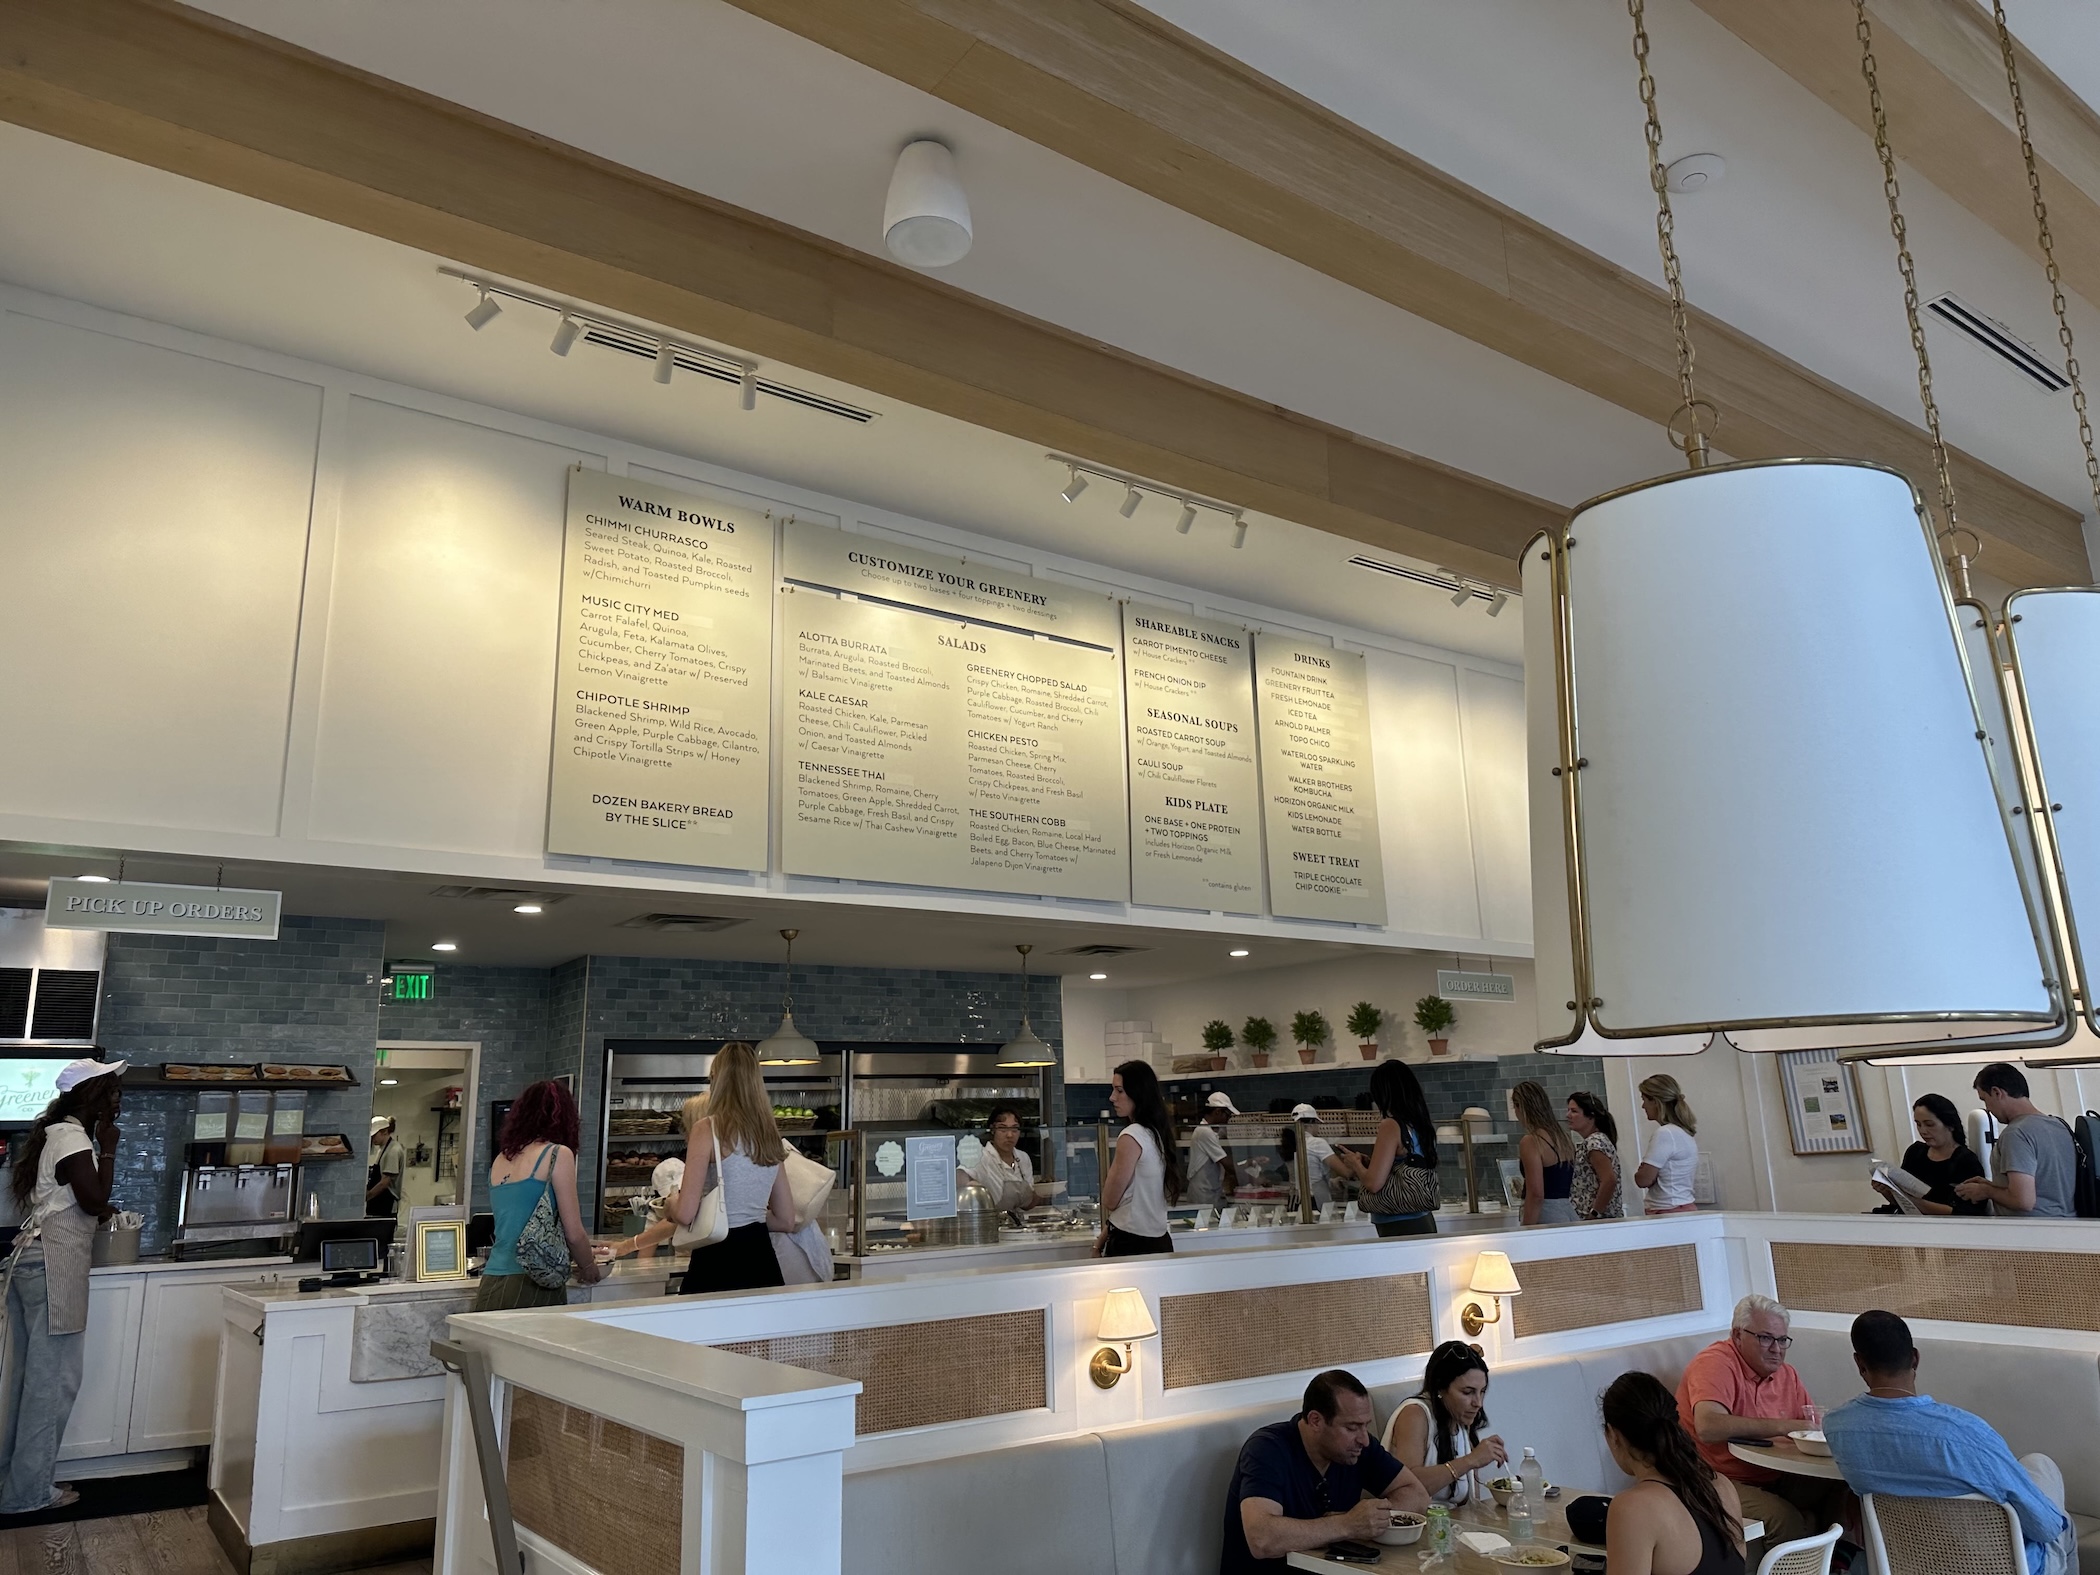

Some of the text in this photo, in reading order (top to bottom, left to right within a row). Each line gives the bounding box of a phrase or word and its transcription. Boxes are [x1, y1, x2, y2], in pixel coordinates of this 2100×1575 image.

[618, 495, 735, 534] WARM BOWLS
[585, 514, 708, 550] CHIMMI CHURRASCO
[584, 527, 753, 574] Seared Steak, Quinoa, Kale, Roasted
[584, 540, 615, 556] Sweet
[617, 548, 652, 565] Potato,
[654, 556, 693, 573] Roasted
[582, 569, 651, 590] w/Chimichurri
[583, 553, 750, 598] Radish, and Toasted Pumpkin seeds
[848, 551, 1047, 607] CUSTOMIZE YOUR GREENERY
[581, 594, 680, 622] MUSIC CITY MED
[580, 607, 689, 638] Carrot Falafel, Quinoa,
[1135, 617, 1240, 649] SHAREABLE SNACKS
[579, 621, 728, 658] Arugula, Feta, Kalamata Olives,
[798, 630, 888, 655] ALOTTA BURRATA
[937, 635, 987, 654] SALADS
[578, 635, 747, 676] Cucumber, Cherry Tomatoes, Crispy
[1132, 636, 1228, 665] CARROT PIMENTO CHEESE
[1294, 652, 1331, 669] DRINKS
[577, 662, 669, 687] Lemon Vinaigrette
[578, 648, 631, 668] Chickpeas,
[633, 660, 652, 670] and
[688, 668, 701, 680] w/
[703, 670, 749, 687] Preserved
[966, 663, 1088, 693] GREENERY CHOPPED SALAD
[1271, 666, 1328, 686] FOUNTAIN DRINK
[1134, 668, 1207, 689] FRENCH ONION DIP
[1264, 678, 1335, 699] GREENERY FRUIT TEA
[576, 689, 690, 716] CHIPOTLE SHRIMP
[799, 688, 869, 708] KALE CAESAR
[1270, 692, 1332, 711] FRESH LEMONADE
[575, 703, 758, 741] Blackened Shrimp, Wild Rice, Avocado,
[798, 701, 833, 715] Roasted
[890, 716, 929, 730] Parmesan
[1147, 707, 1238, 733] SEASONAL SOUPS
[1287, 708, 1318, 721] ICED TEA
[1136, 725, 1226, 748] ROASTED CARROT SOUP
[1274, 719, 1331, 736] ARNOLD PALMER
[967, 729, 1039, 748] CHICKEN PESTO
[1289, 734, 1331, 749] TOPO CHICO
[573, 746, 673, 768] Chipotle Vinaigrette
[1137, 757, 1184, 772] CAULI SOUP
[1280, 748, 1356, 768] WATERLOO SPARKLING
[1299, 761, 1323, 772] WATER
[798, 760, 885, 781] TENNESSEE THAI
[798, 773, 841, 788] Blackened
[913, 788, 939, 802] Cherry
[1287, 775, 1353, 793] WALKER BROTHERS
[1293, 785, 1333, 798] KOMBUCHA
[592, 794, 734, 819] DOZEN BAKERY BREAD
[1165, 796, 1228, 815] KIDS PLATE
[1273, 795, 1355, 815] HORIZON ORGANIC MILK
[605, 812, 621, 823] BY
[625, 814, 649, 826] THE
[968, 808, 1066, 828] THE SOUTHERN COBB
[1144, 814, 1162, 825] ONE
[1163, 817, 1184, 828] BASE
[1190, 821, 1207, 831] ONE
[1208, 823, 1241, 835] PROTEIN
[1287, 810, 1342, 826] KIDS LEMONADE
[1150, 827, 1169, 837] TWO
[1169, 829, 1209, 842] TOPPINGS
[1291, 824, 1342, 839] WATER BOTTLE
[1292, 851, 1360, 869] SWEET TREAT
[1233, 882, 1252, 892] gluten
[1293, 871, 1363, 887] TRIPLE CHOCOLATE
[1295, 882, 1313, 891] CHIP
[65, 895, 263, 922] PICK UP ORDERS
[395, 975, 430, 1000] EXIT
[1446, 980, 1509, 995] ORDER HERE
